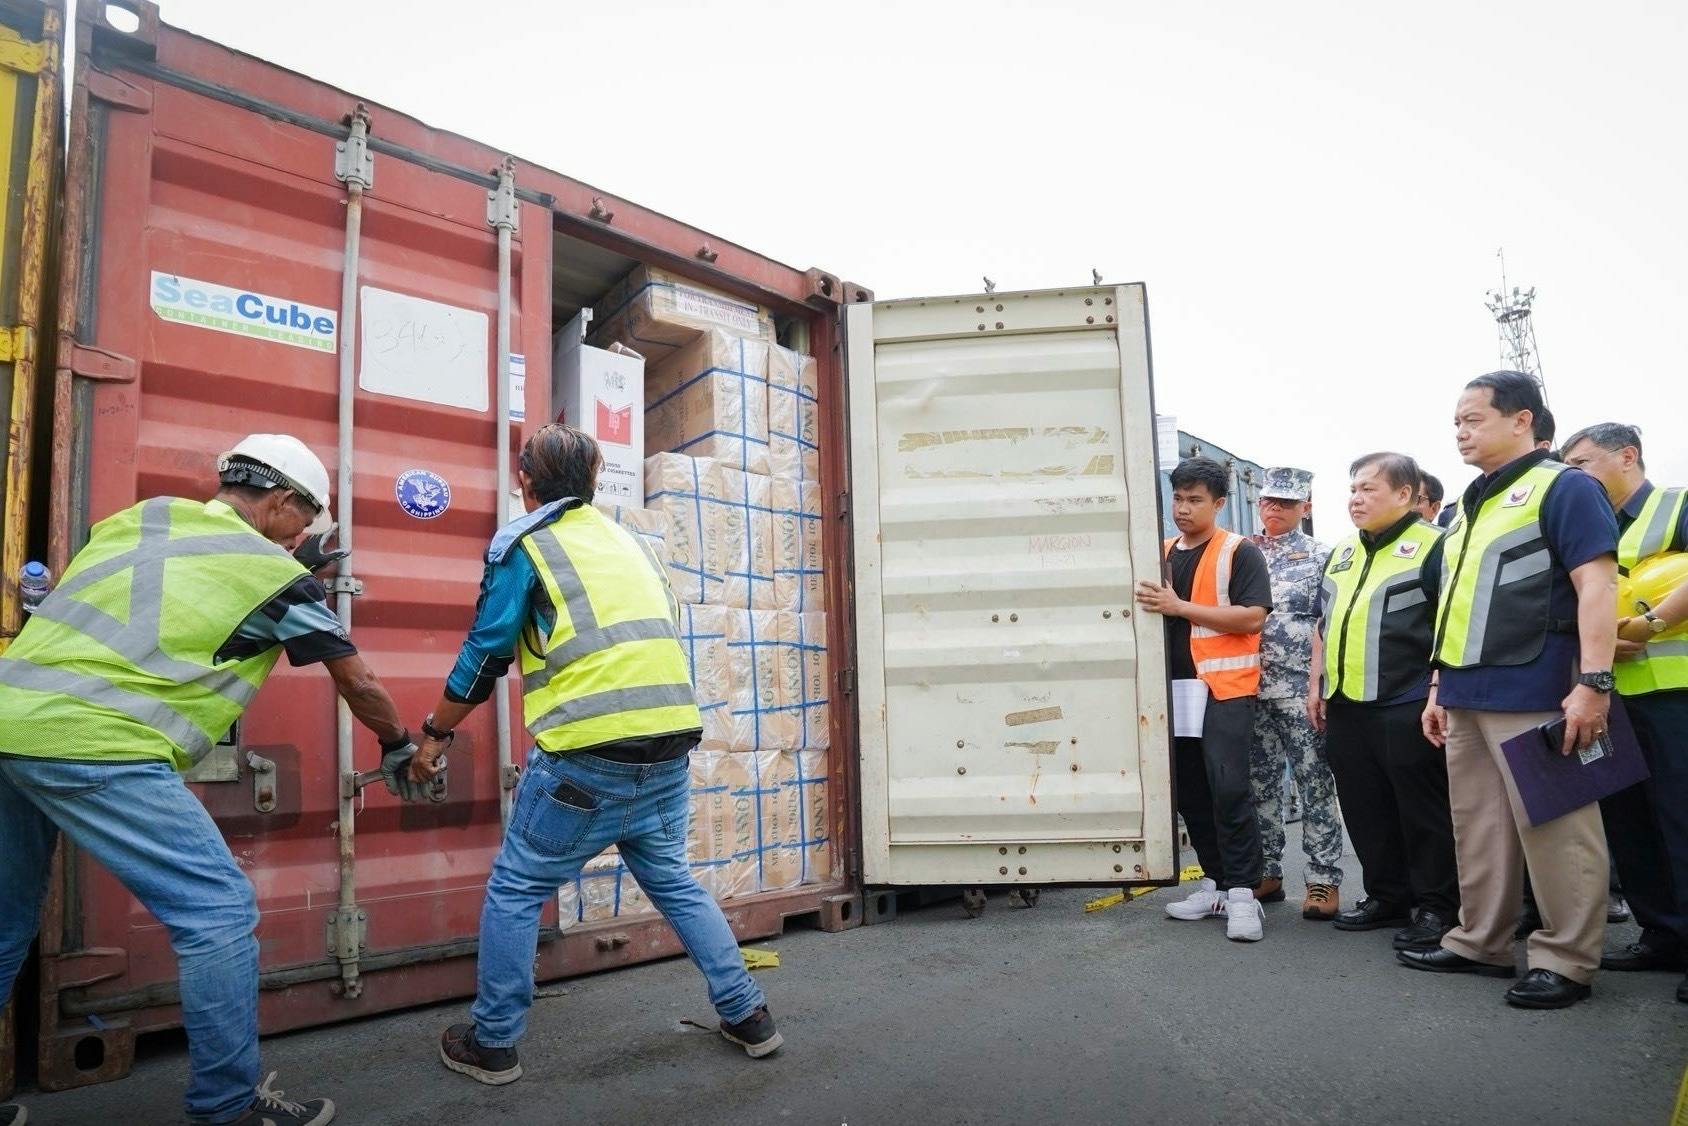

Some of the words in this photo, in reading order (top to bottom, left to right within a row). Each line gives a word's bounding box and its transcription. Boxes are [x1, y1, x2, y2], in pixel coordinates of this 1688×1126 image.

[153, 276, 335, 335] SeaCube
[156, 307, 249, 331] CONTAINER
[267, 330, 333, 349] LEASING
[402, 500, 411, 509] OF
[410, 505, 445, 518] SHIPPING
